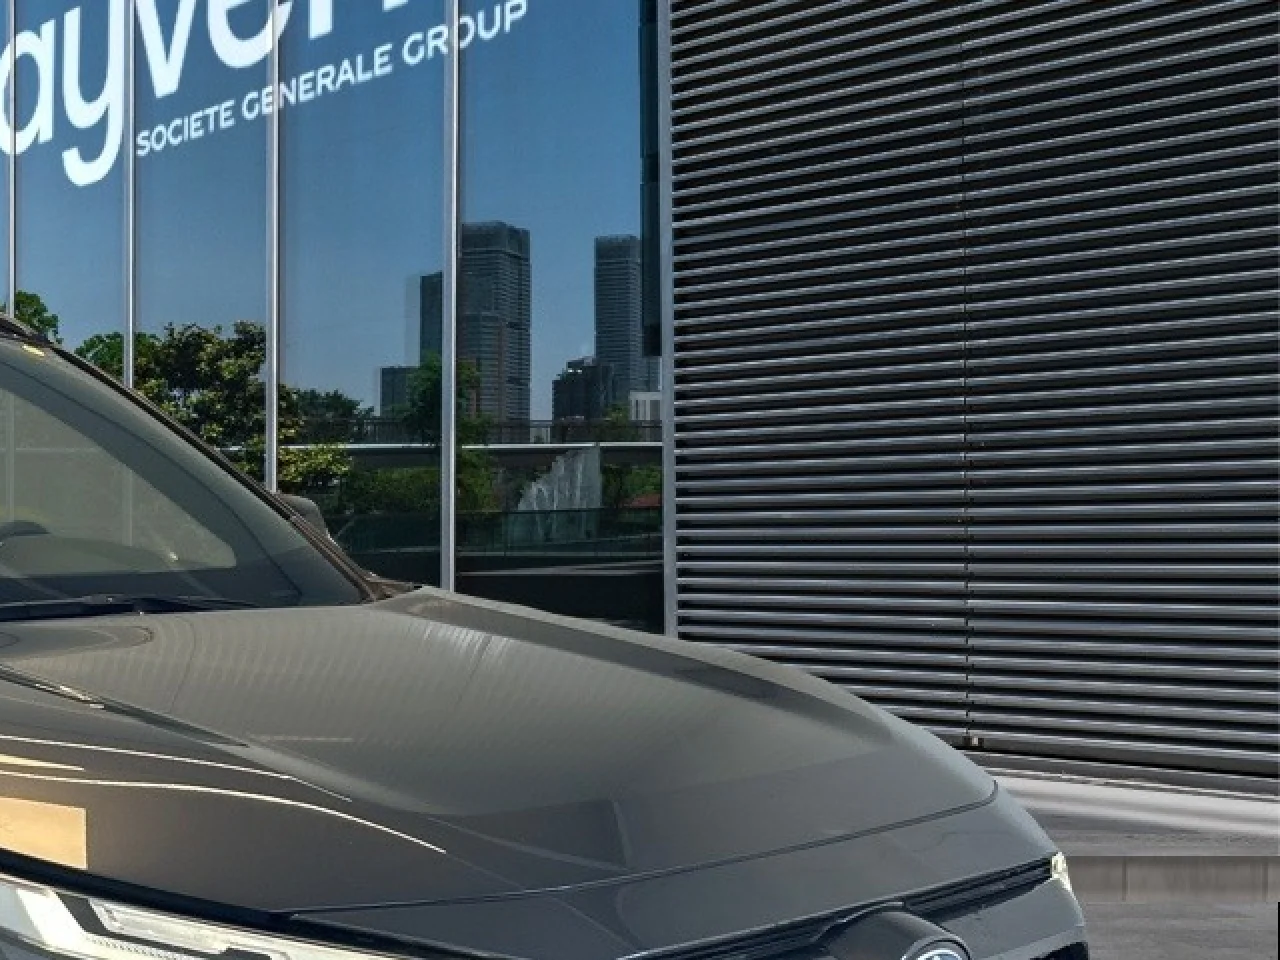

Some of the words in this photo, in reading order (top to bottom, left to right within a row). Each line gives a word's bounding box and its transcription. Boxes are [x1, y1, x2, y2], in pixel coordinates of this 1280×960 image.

[136, 103, 235, 157] SOCIETE
[241, 43, 393, 121] GENERALE
[401, 0, 527, 66] GROUP
